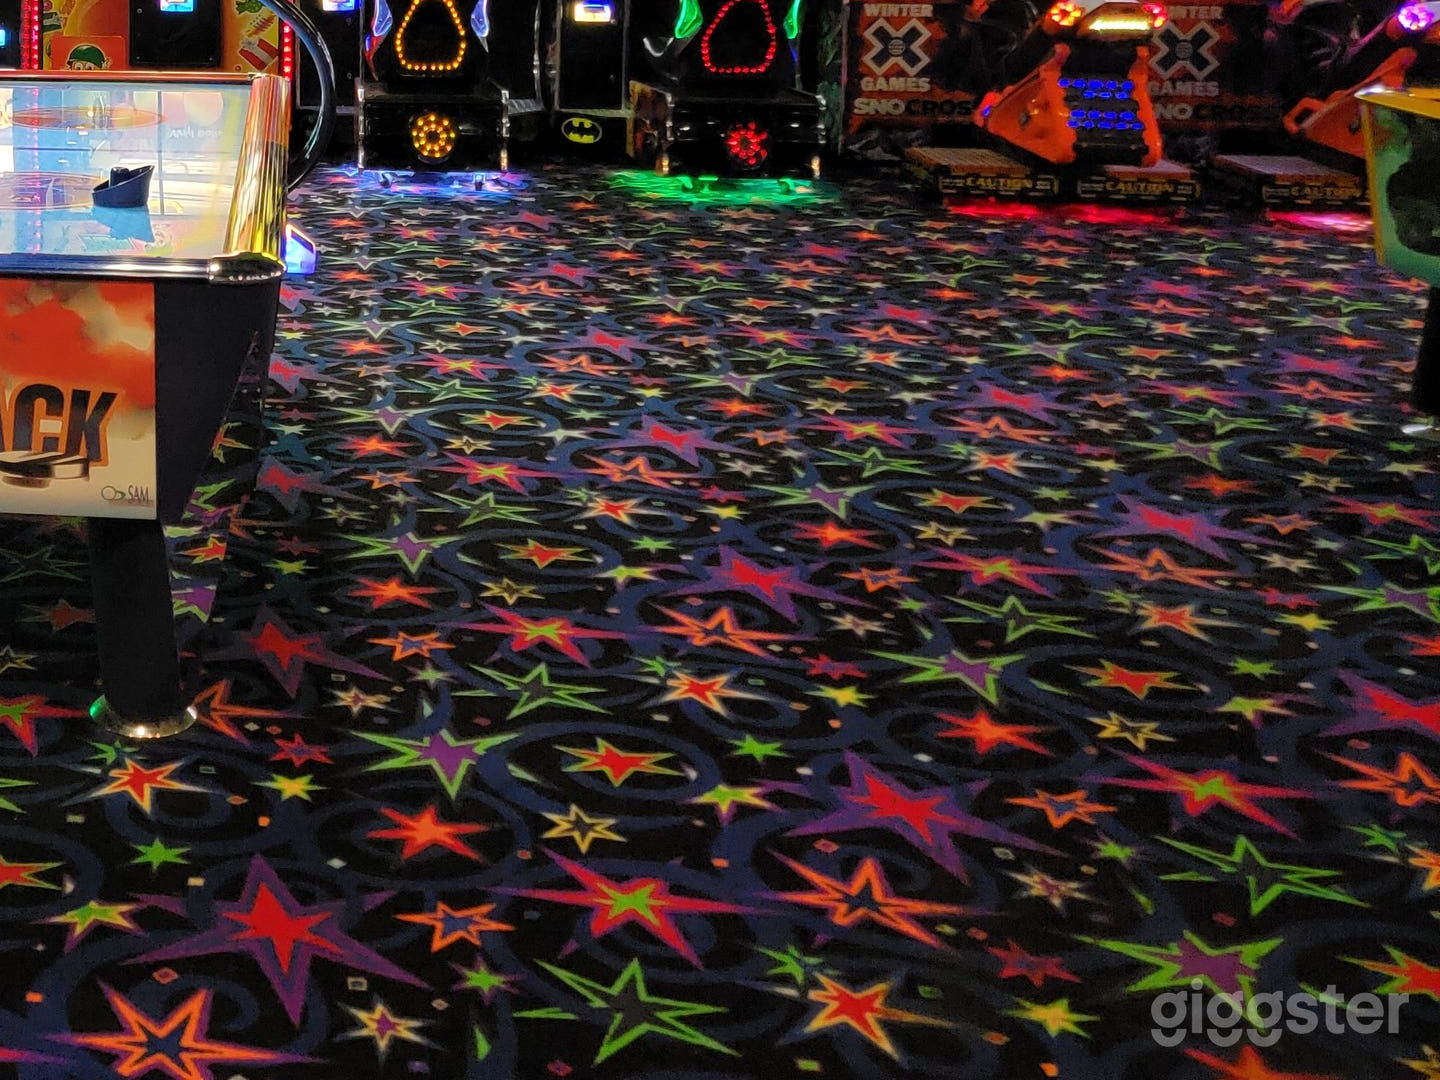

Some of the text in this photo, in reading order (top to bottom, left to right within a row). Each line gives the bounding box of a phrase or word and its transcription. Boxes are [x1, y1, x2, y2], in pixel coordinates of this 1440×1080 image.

[863, 3, 933, 18] WINTER
[861, 77, 931, 92] GAMES
[1148, 81, 1220, 97] GAMES
[965, 178, 1033, 190] CAUTION
[1105, 180, 1174, 193] CAUTION
[127, 484, 150, 505] SAM
